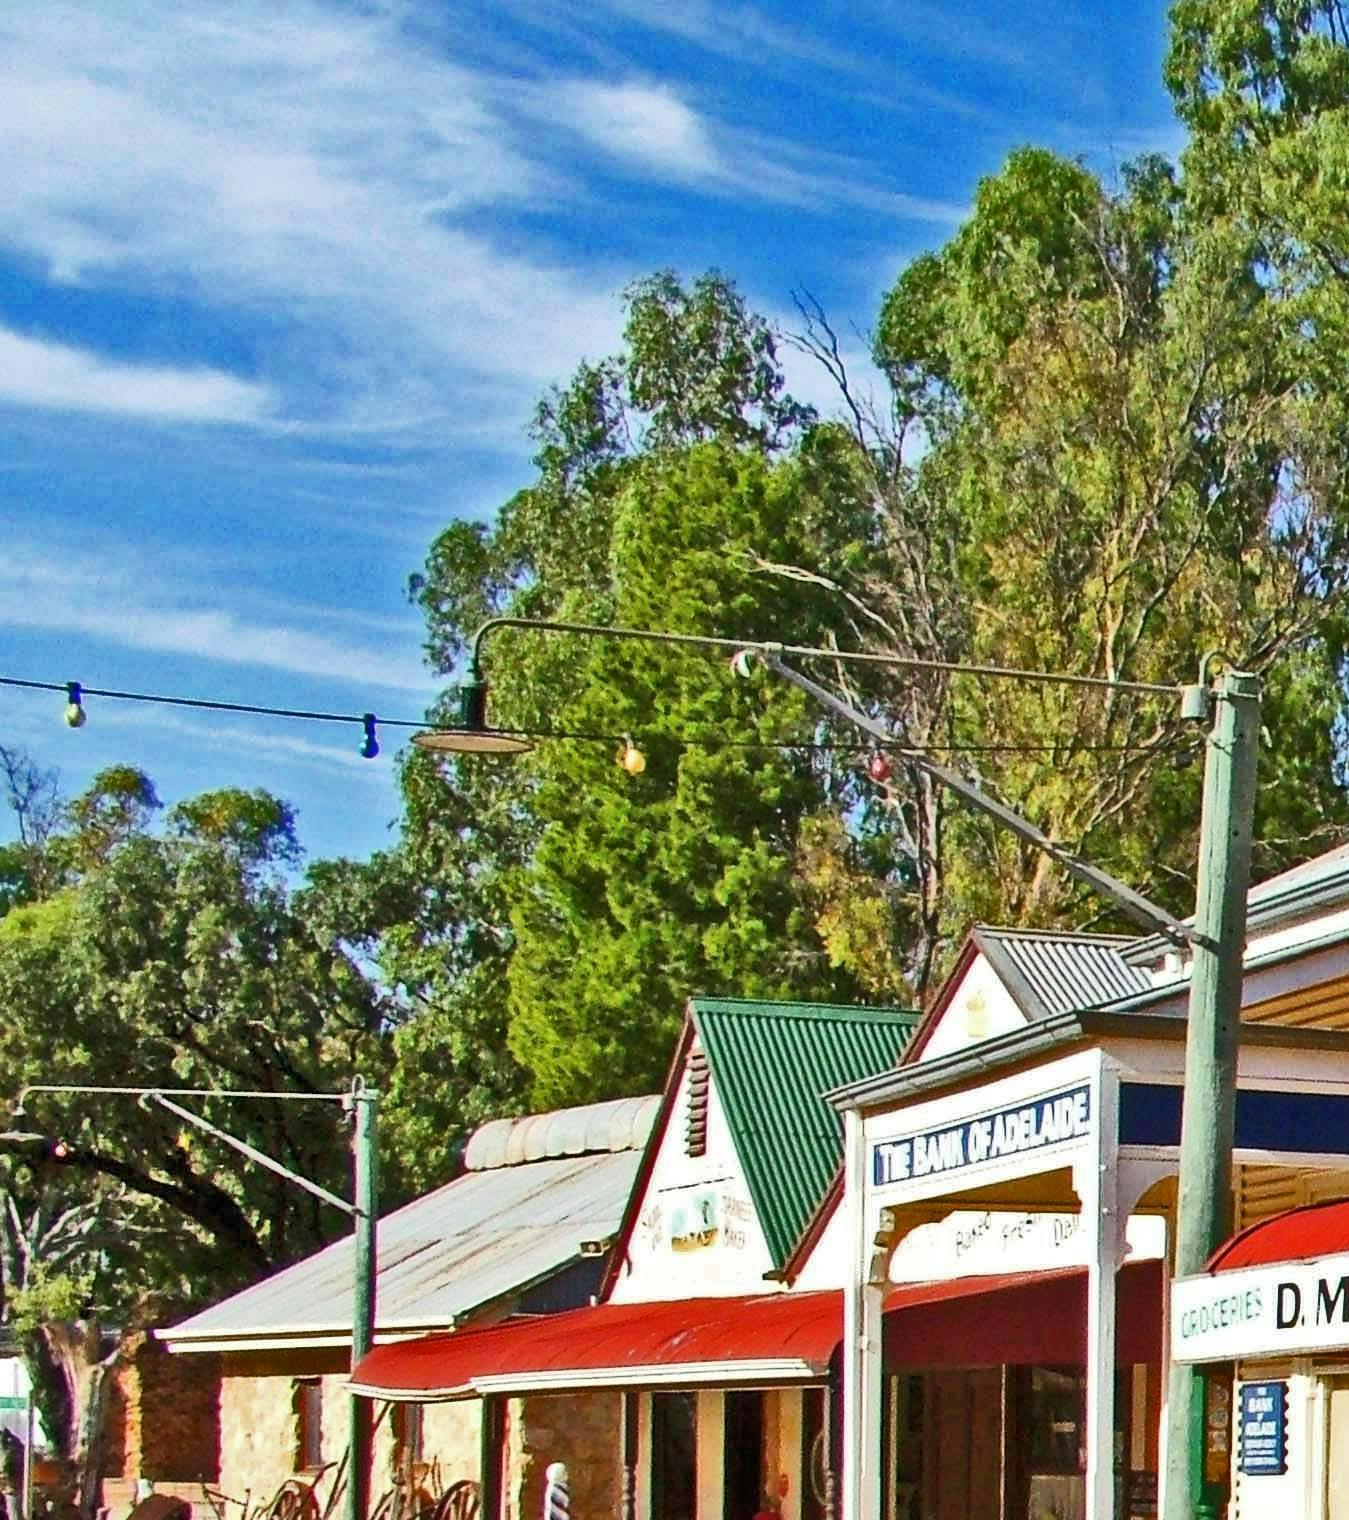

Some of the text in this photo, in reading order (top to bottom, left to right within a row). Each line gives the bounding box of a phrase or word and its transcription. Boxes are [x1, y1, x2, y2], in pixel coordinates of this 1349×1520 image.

[913, 1128, 965, 1177] BANK
[967, 1120, 992, 1164] OF
[990, 1092, 1087, 1157] ADELAIDE
[1181, 1288, 1263, 1338] GROCERIES
